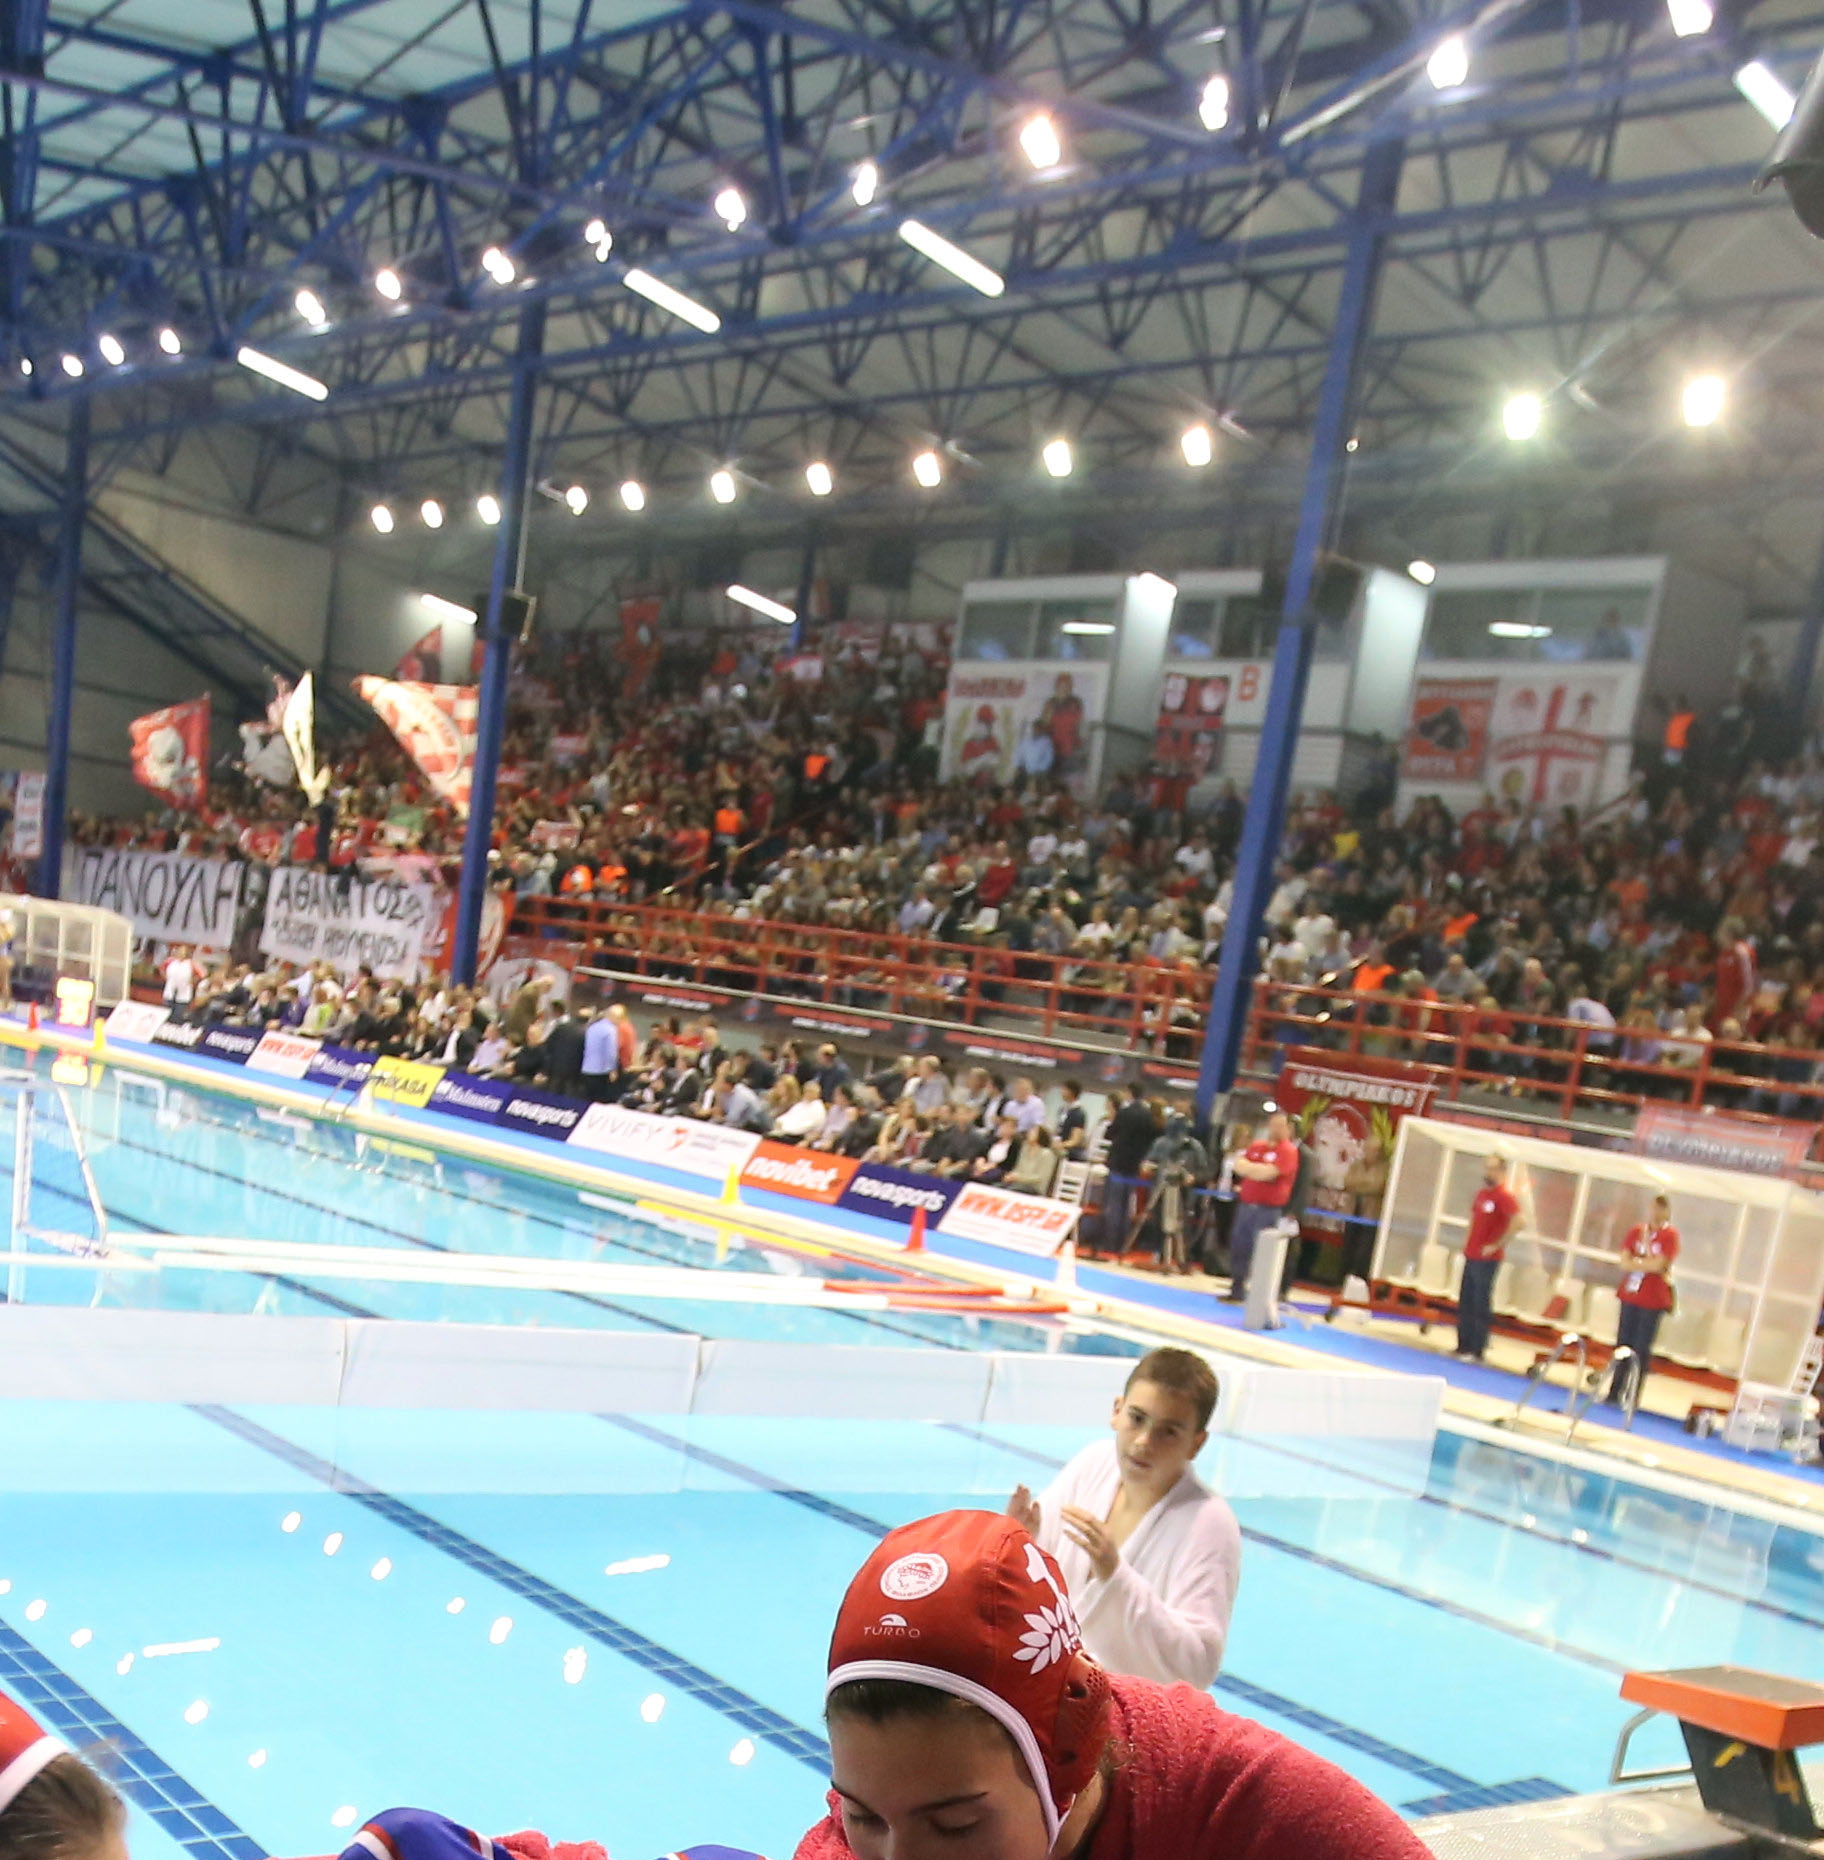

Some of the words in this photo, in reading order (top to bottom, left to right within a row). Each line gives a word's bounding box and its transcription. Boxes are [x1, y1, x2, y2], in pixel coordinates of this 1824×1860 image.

[587, 1112, 666, 1143] VIVIFY
[746, 1155, 839, 1193] novibet
[853, 1174, 947, 1212] novasports
[863, 1625, 921, 1639] TURBO
